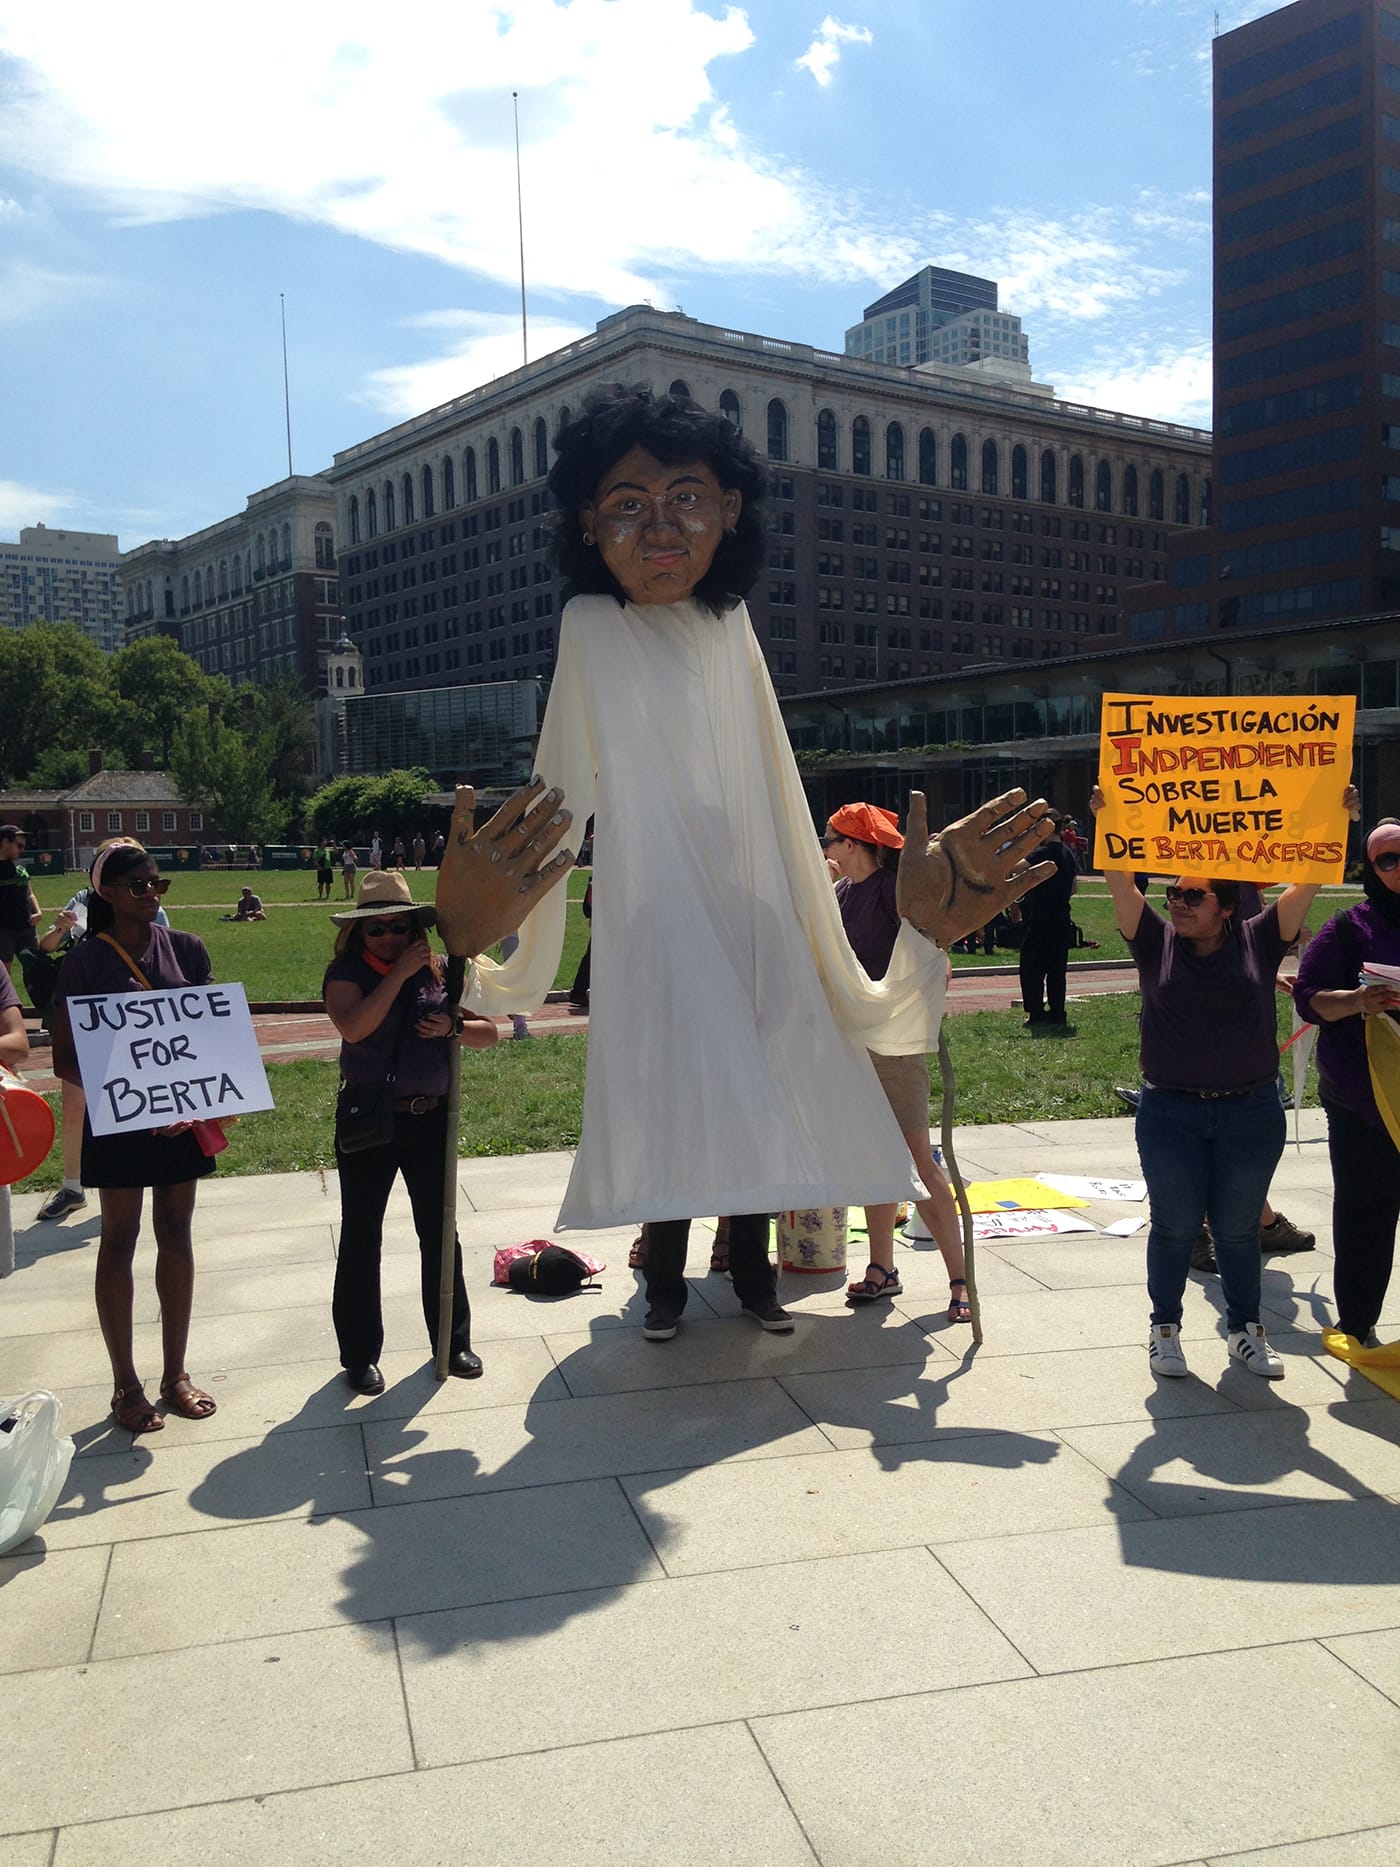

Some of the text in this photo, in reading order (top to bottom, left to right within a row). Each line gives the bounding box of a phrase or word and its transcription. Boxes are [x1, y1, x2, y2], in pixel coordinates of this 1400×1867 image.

[1106, 700, 1340, 737] INVESTIGACIÓN
[1110, 737, 1338, 777] INDPENDIENTE
[1118, 777, 1278, 804] SOBRE LA
[1168, 806, 1283, 835] MUERTE
[1104, 832, 1344, 864] DE BERTA CÁCERES
[72, 991, 231, 1032] JUSTICE
[129, 1034, 198, 1070] FOR
[102, 1072, 245, 1124] BERTA
